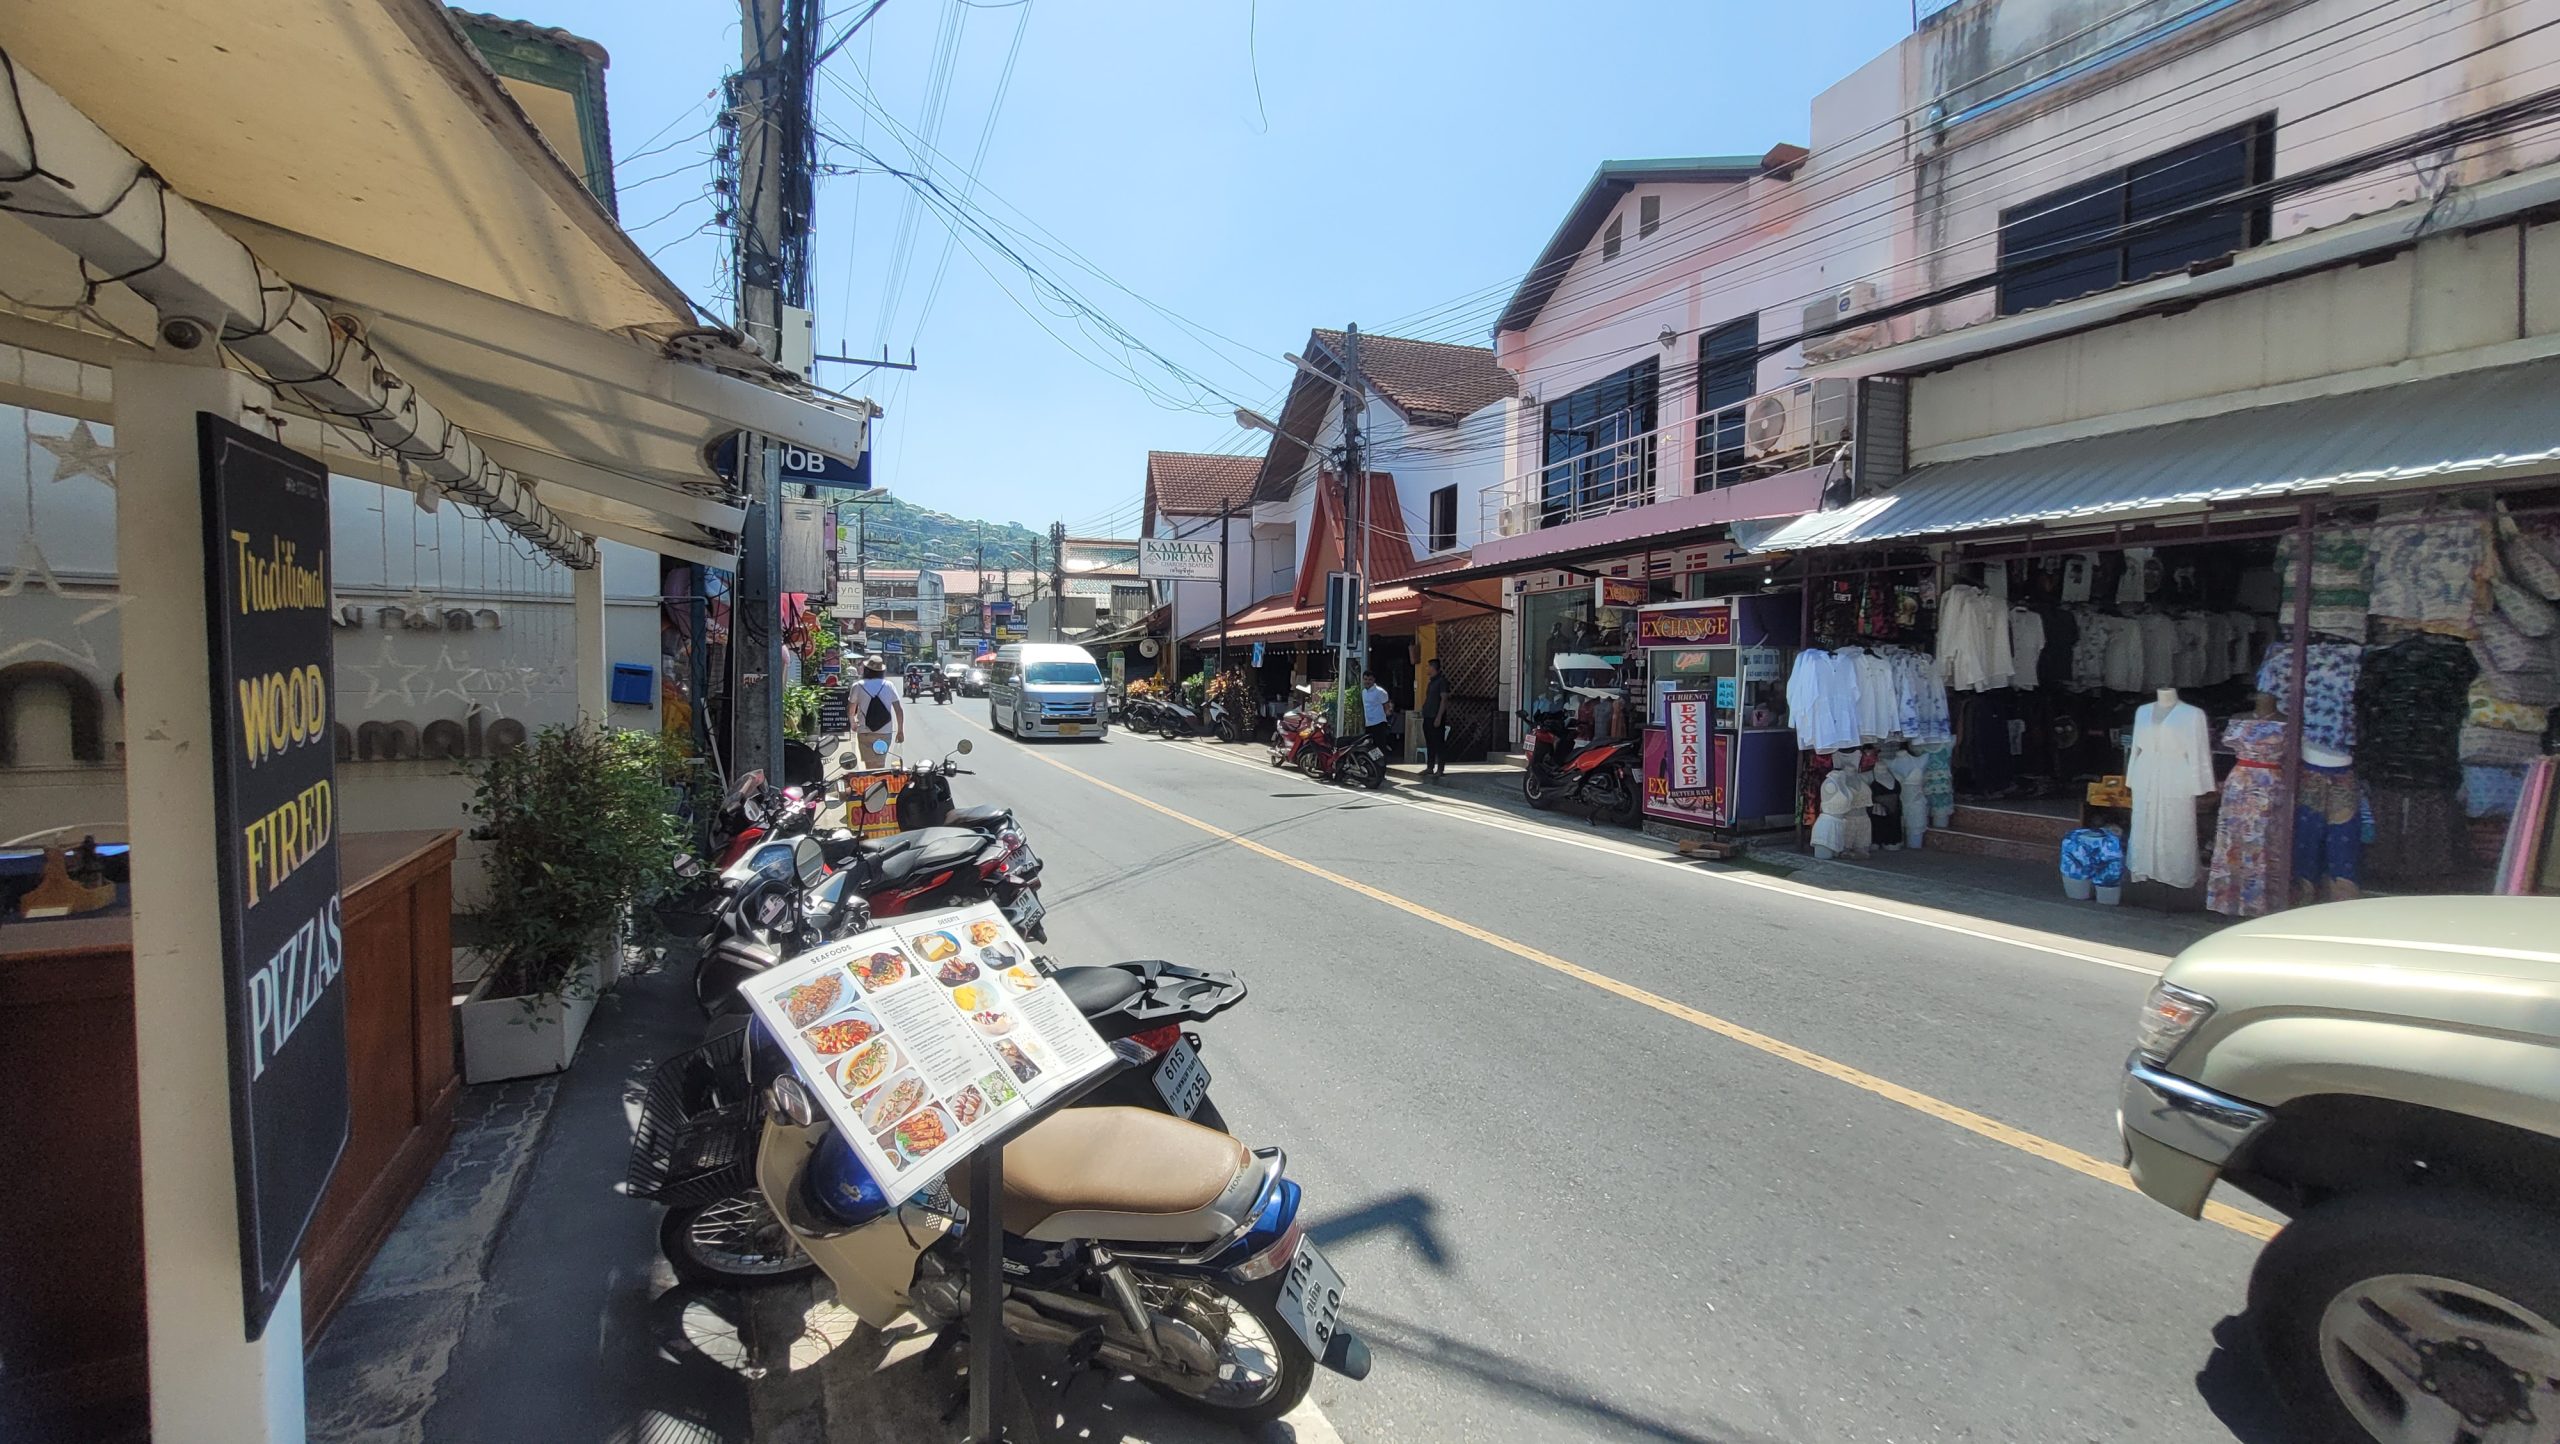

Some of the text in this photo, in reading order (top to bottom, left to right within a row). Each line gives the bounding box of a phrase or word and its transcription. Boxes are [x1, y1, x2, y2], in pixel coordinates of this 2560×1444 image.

[1146, 541, 1213, 554] KAMALA
[1162, 553, 1214, 563] DREAMS
[231, 529, 326, 615] Traditional
[1605, 584, 1648, 601] EXCHANGE
[1641, 616, 1729, 638] EXCHANGE
[1675, 652, 1706, 670] Open
[1667, 693, 1709, 701] CURRENCY
[240, 664, 326, 769] WOOD
[1680, 703, 1698, 786] EXCHANGE
[1671, 789, 1695, 797] BETTER
[245, 780, 332, 909] FIRED
[937, 915, 960, 926] DESERTS
[810, 944, 852, 965] SEAFOODS
[249, 892, 342, 1082] PIZZAS
[1183, 1072, 1205, 1113] 4735
